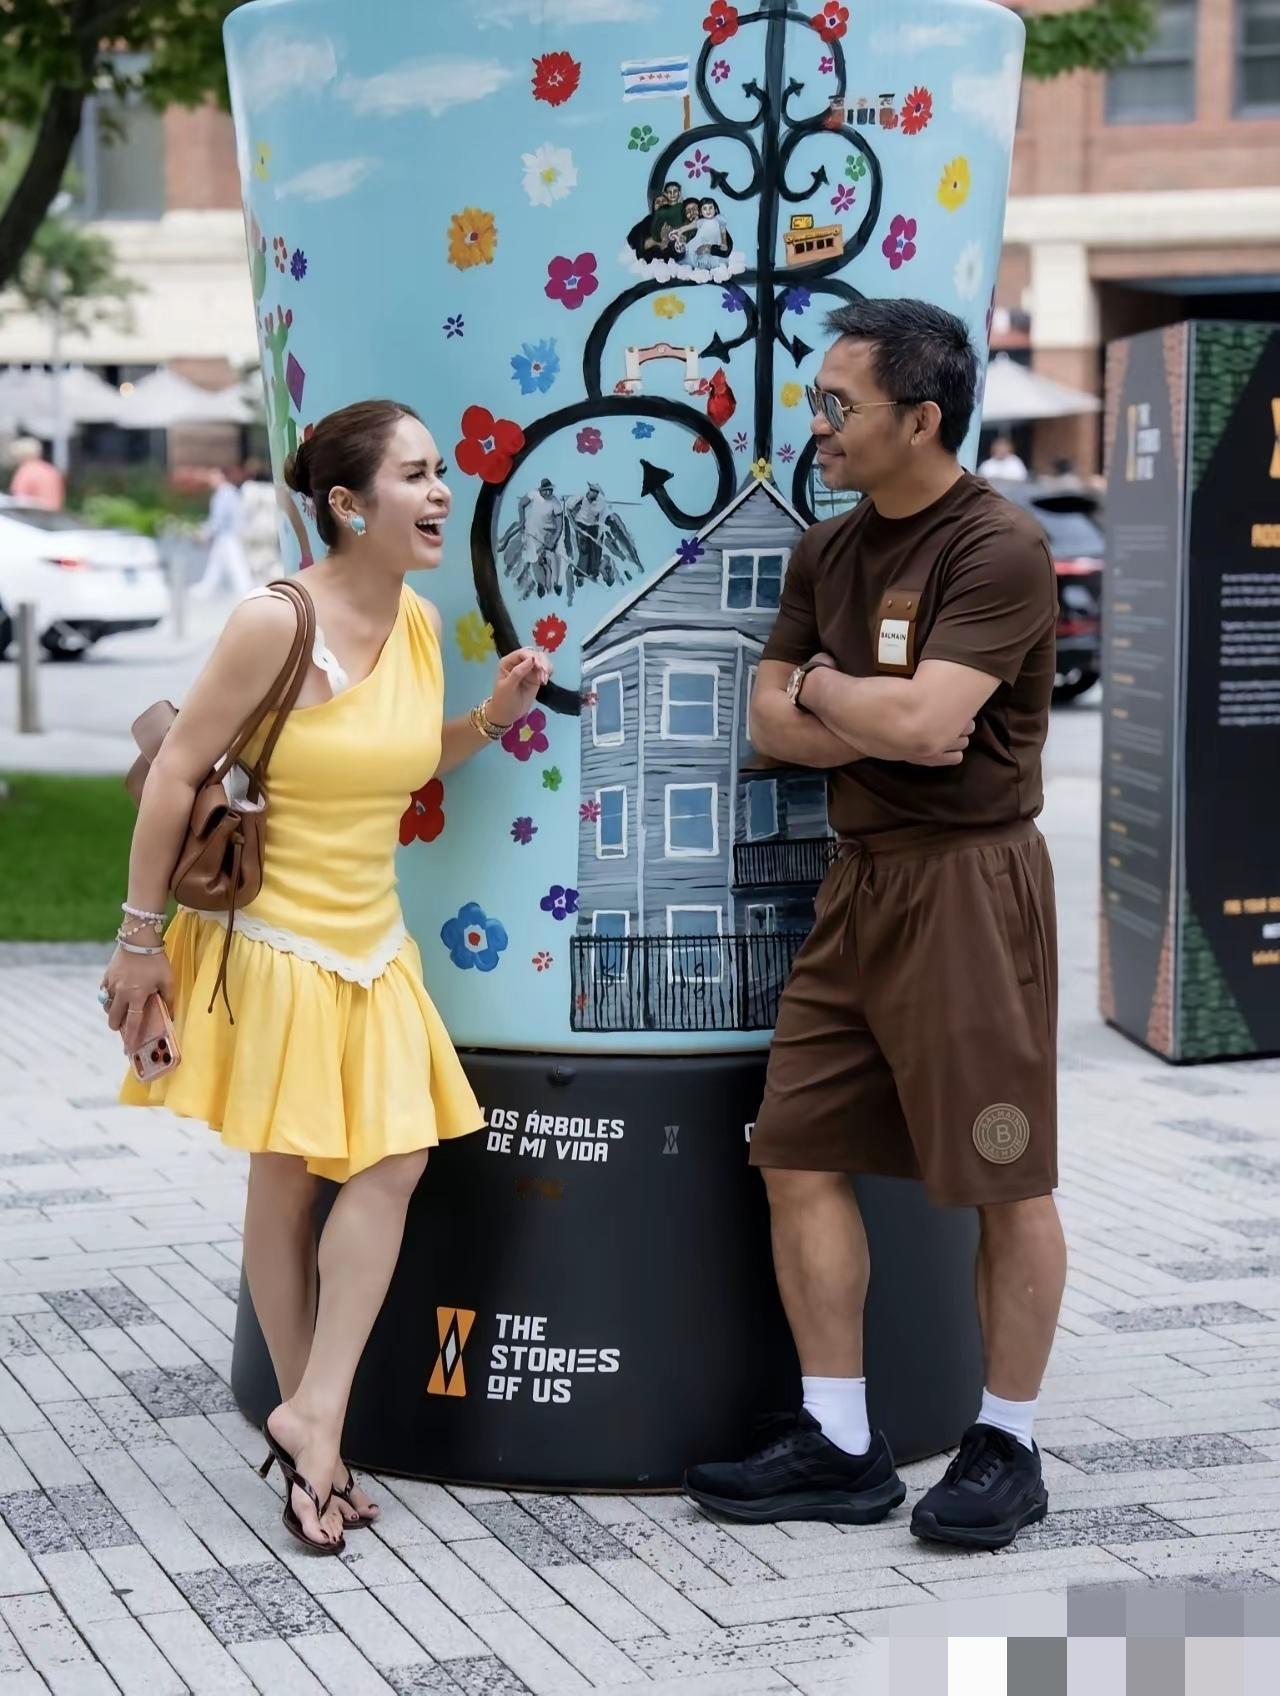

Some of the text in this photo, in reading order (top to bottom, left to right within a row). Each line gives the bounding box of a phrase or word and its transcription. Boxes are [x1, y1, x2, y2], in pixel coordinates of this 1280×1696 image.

[881, 632, 906, 640] BALMAIN
[525, 1110, 624, 1139] ÁRBOLES
[996, 1124, 1011, 1142] B
[487, 1132, 608, 1162] DE MI VIDA
[496, 1313, 547, 1341] THE
[490, 1344, 621, 1373] STORIES
[487, 1375, 572, 1403] OF US
